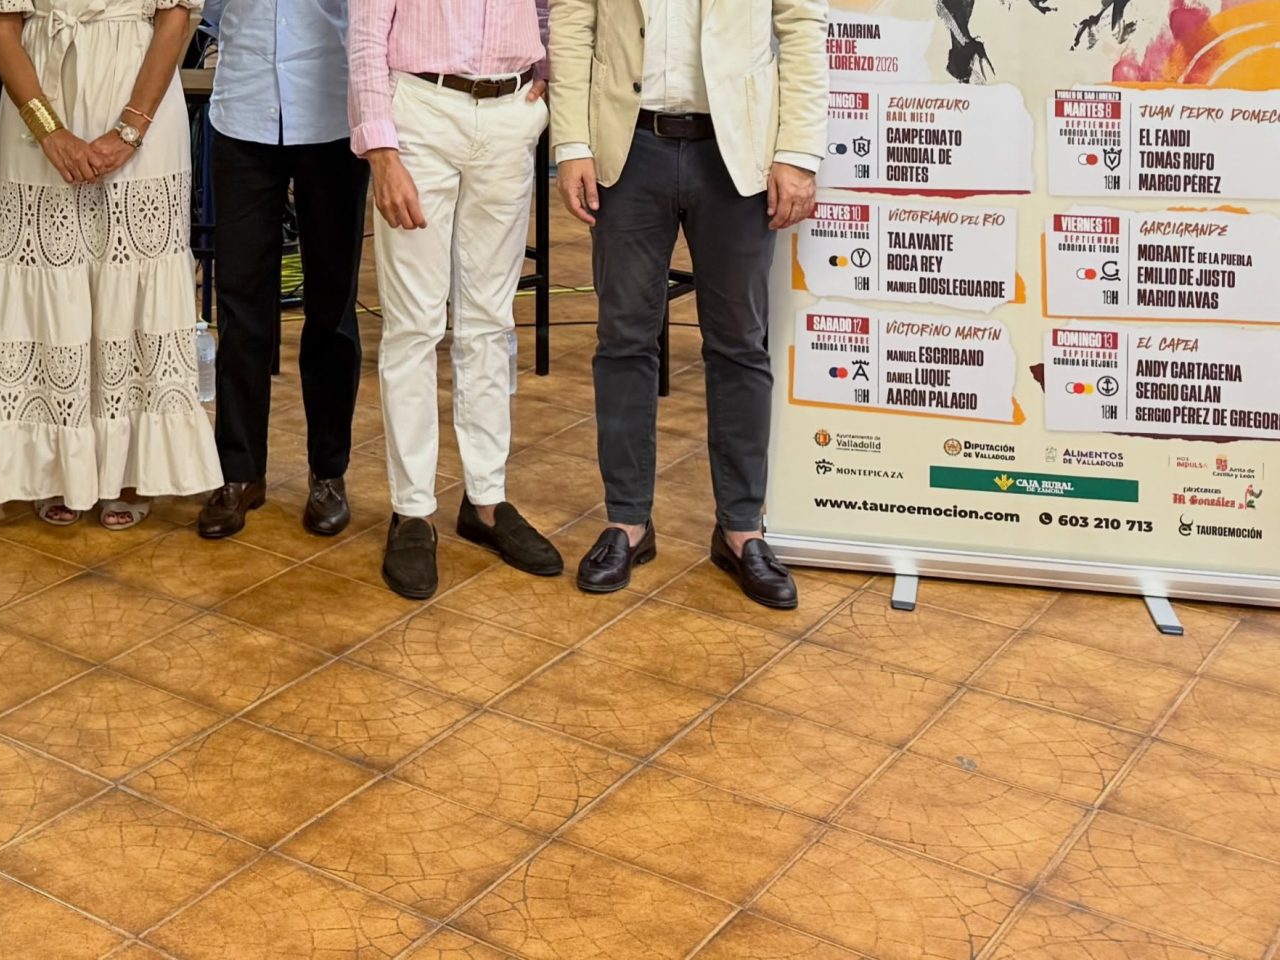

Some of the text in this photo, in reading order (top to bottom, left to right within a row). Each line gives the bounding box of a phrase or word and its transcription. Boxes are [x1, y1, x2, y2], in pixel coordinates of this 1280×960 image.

[836, 23, 881, 39] TAURINA
[845, 40, 857, 54] DE
[829, 55, 898, 72] LORENZO 2026
[1064, 101, 1105, 118] MARTES
[1139, 104, 1175, 119] JUAN
[1180, 105, 1223, 121] PEDRO
[886, 127, 962, 147] CAMPEONATO
[1139, 128, 1153, 146] EL
[1154, 129, 1191, 147] FANDI
[886, 146, 952, 165] MUNDIAL DE
[1183, 152, 1215, 171] RUFO
[886, 166, 929, 183] CORTES
[1138, 173, 1181, 192] MARCO
[815, 204, 850, 220] JUEVES
[1061, 215, 1103, 233] VIERNES
[887, 231, 954, 252] TALAVANTE
[887, 253, 943, 273] ROCA REY
[1138, 244, 1253, 267] MORANTE DE LA PUEBLA
[1137, 267, 1236, 288] EMILIO DE JUSTO
[886, 277, 1006, 299] MANUEL DIOSLEGUARDE
[1137, 289, 1219, 309] MARIO NAVAS
[1057, 330, 1102, 348] DOMINGO
[1136, 336, 1153, 350] EL
[886, 347, 984, 367] MANUEL ESCRIBANO
[886, 368, 951, 387] DANIEL LUQUE
[1136, 359, 1170, 379] ANDY
[1170, 361, 1243, 383] CARTAGENA
[928, 392, 978, 410] PALACIO
[1136, 382, 1178, 402] SERGIO
[1135, 407, 1171, 423] SERGIO
[1212, 409, 1227, 426] DE
[836, 439, 881, 450] Valladolid
[1041, 480, 1074, 491] RURAL
[814, 497, 1020, 523] www.tauroemocion.com
[1058, 514, 1153, 533] 603 210 713
[1196, 525, 1263, 540] TAUROEMOCIÓN
